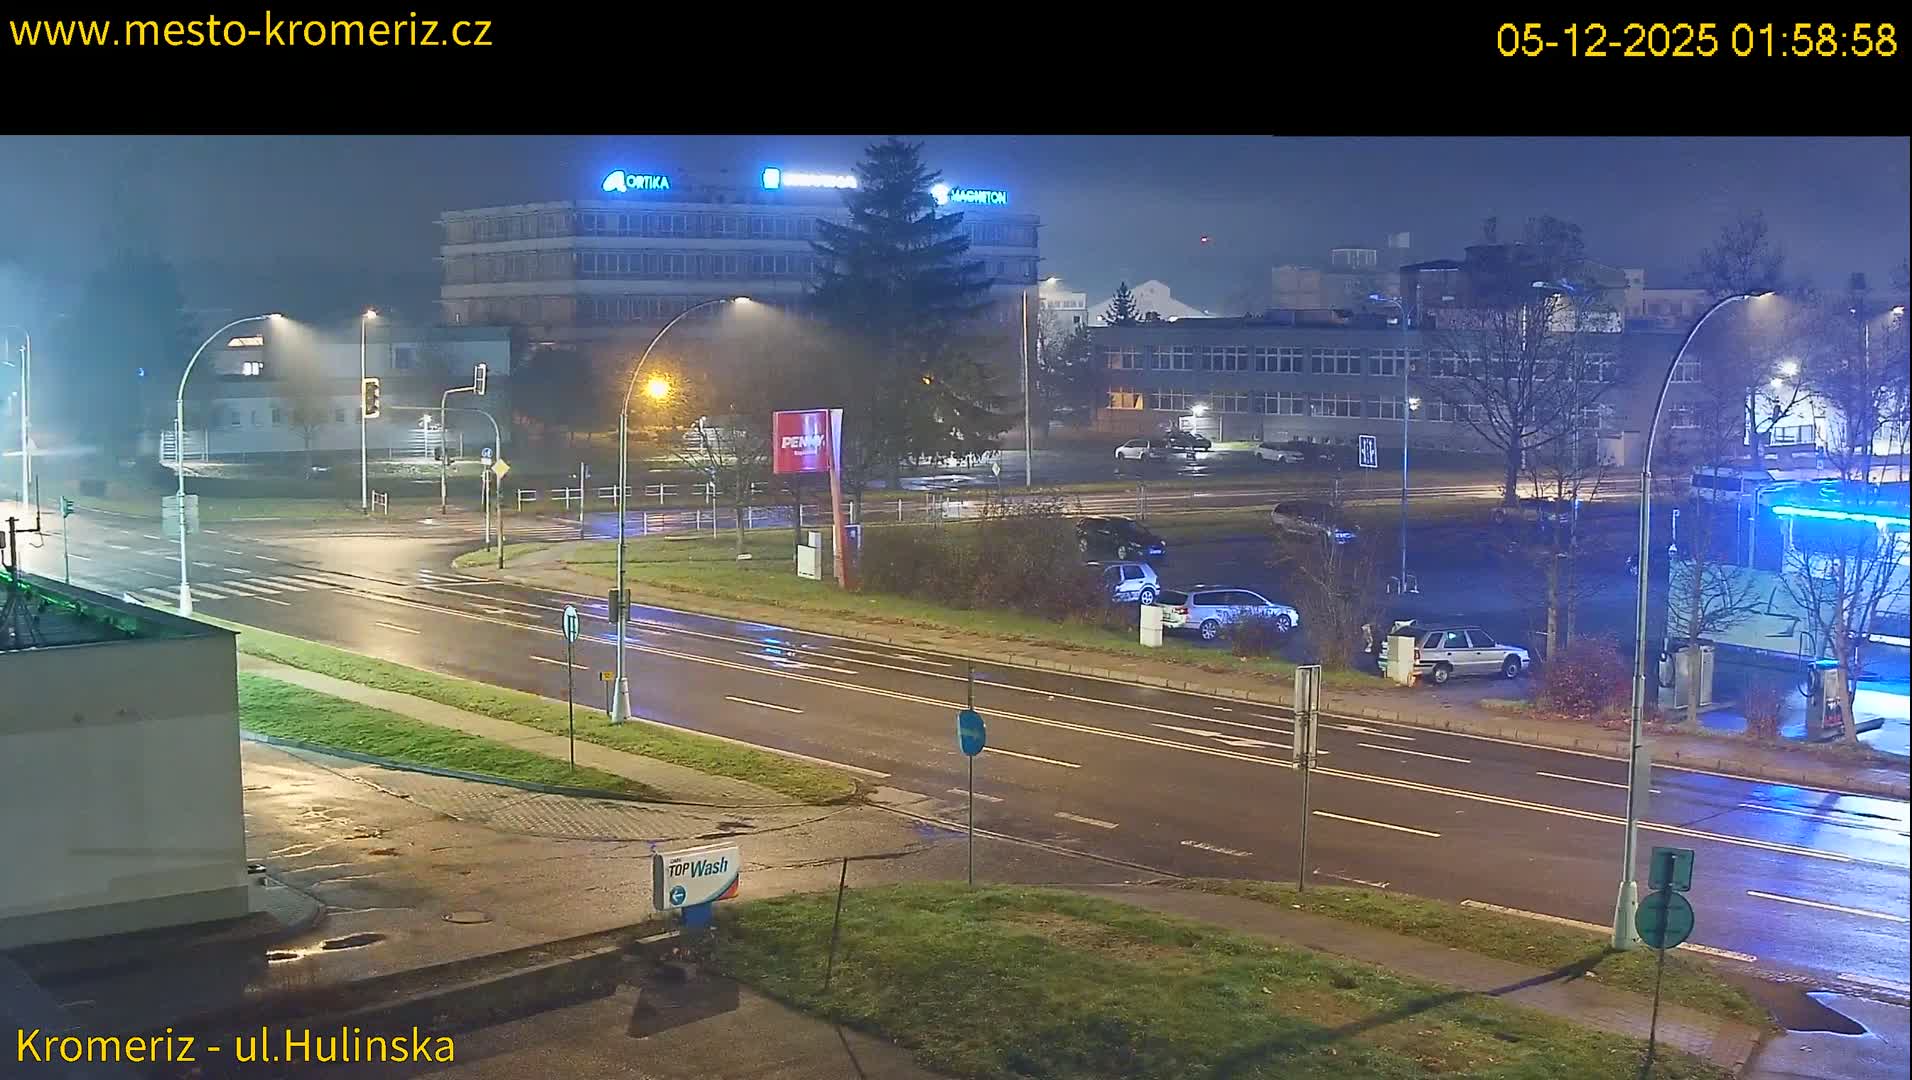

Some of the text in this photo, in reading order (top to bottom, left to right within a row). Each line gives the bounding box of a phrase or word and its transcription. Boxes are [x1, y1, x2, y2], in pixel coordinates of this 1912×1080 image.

[626, 174, 670, 190] ORTIKA
[668, 856, 728, 878] TOP Wash
